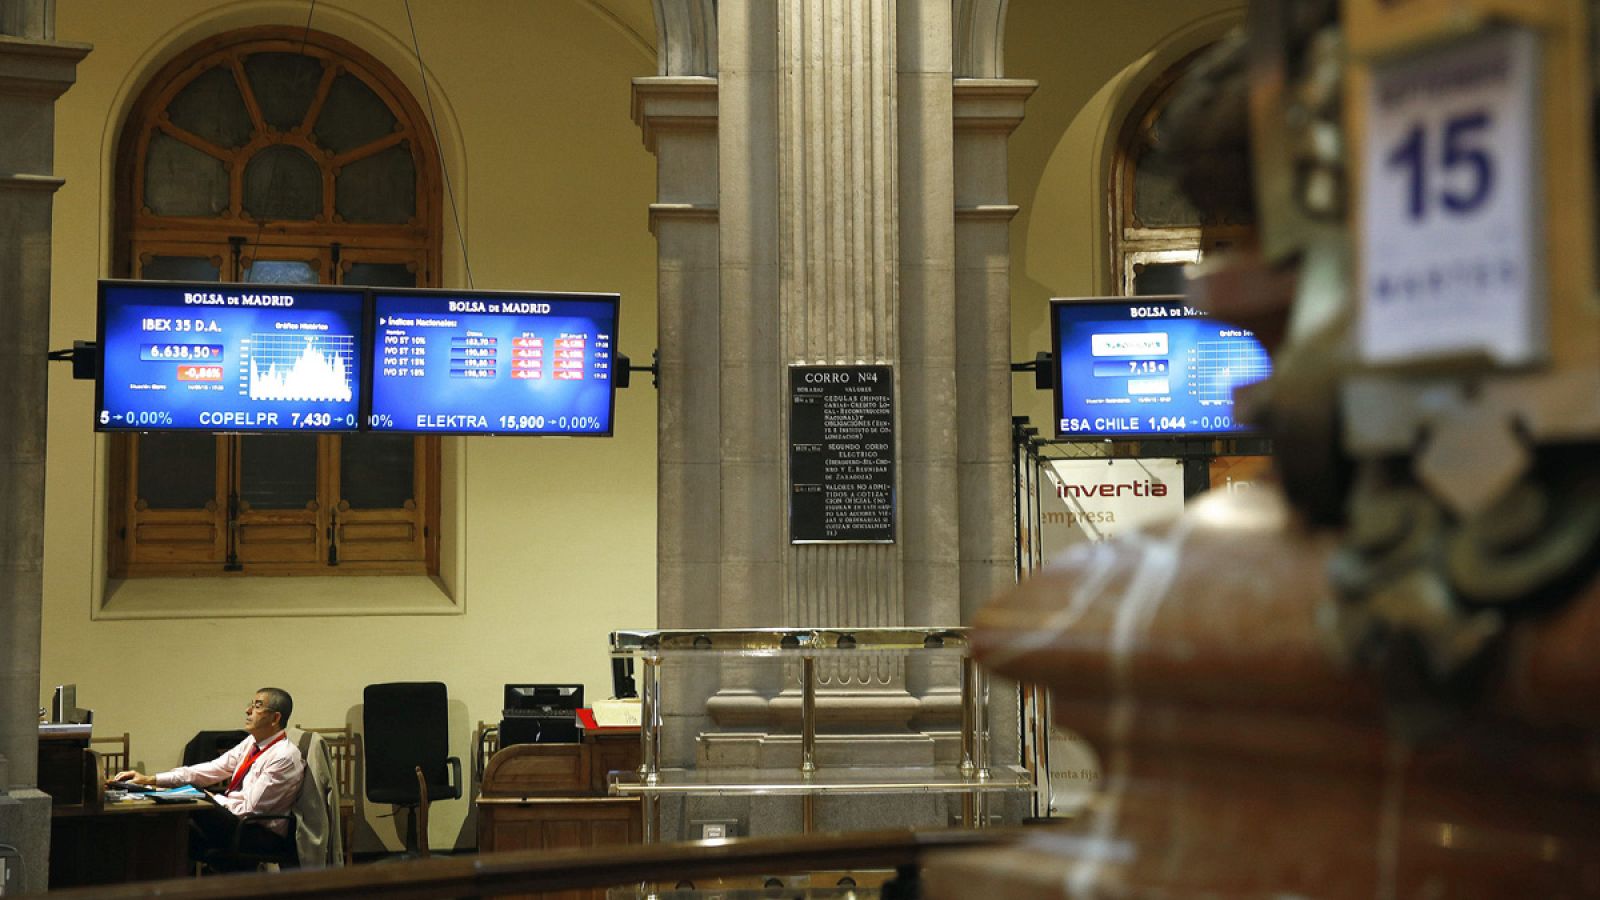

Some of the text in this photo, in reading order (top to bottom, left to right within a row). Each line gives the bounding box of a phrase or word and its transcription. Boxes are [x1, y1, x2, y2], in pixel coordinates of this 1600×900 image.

[1385, 111, 1495, 223] 15
[183, 293, 224, 305] BOLSA
[242, 294, 294, 306] MADRID
[448, 301, 486, 313] BOLSA
[502, 302, 550, 314] MADRID
[1130, 307, 1168, 318] BOLSA
[142, 318, 222, 332] IBEX 35 D.A.
[150, 345, 211, 359] 6.638,50
[804, 372, 850, 384] CORRO
[100, 410, 110, 424] 5
[126, 411, 173, 426] 0,00%
[199, 412, 278, 425] COPELPR
[291, 412, 331, 427] 7,430
[416, 415, 488, 428] ELEKTRA
[499, 416, 545, 430] 15,900
[559, 416, 600, 430] 0,00%
[1060, 419, 1091, 431] ESA
[1095, 417, 1140, 430] CHILE
[1148, 416, 1186, 431] 1,044
[1057, 479, 1168, 498] invertia
[1041, 510, 1116, 528] empresa
